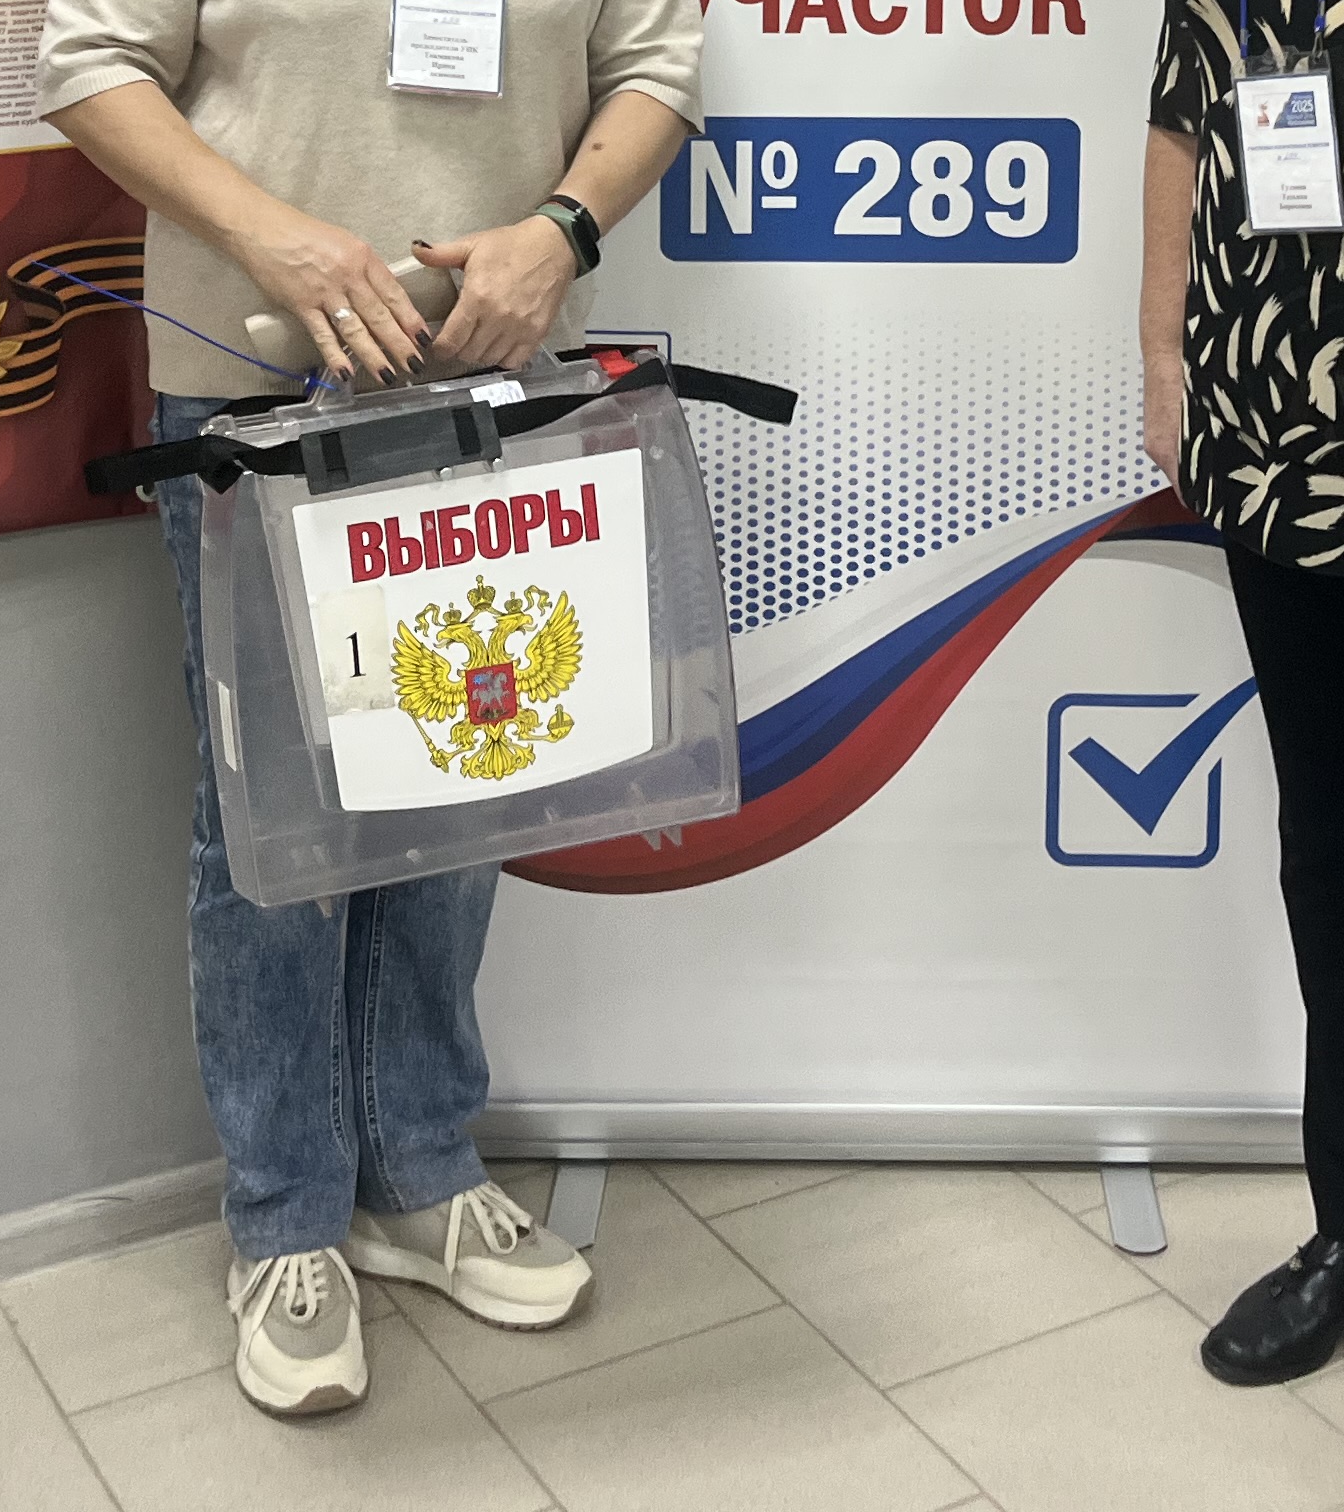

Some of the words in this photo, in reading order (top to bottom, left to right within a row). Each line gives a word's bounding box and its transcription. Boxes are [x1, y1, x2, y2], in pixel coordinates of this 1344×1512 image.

[1291, 99, 1314, 113] 2025
[689, 139, 799, 235] №
[833, 139, 1050, 239] 289
[347, 483, 601, 583] ВЫБОРЫ
[346, 631, 367, 678] 1
